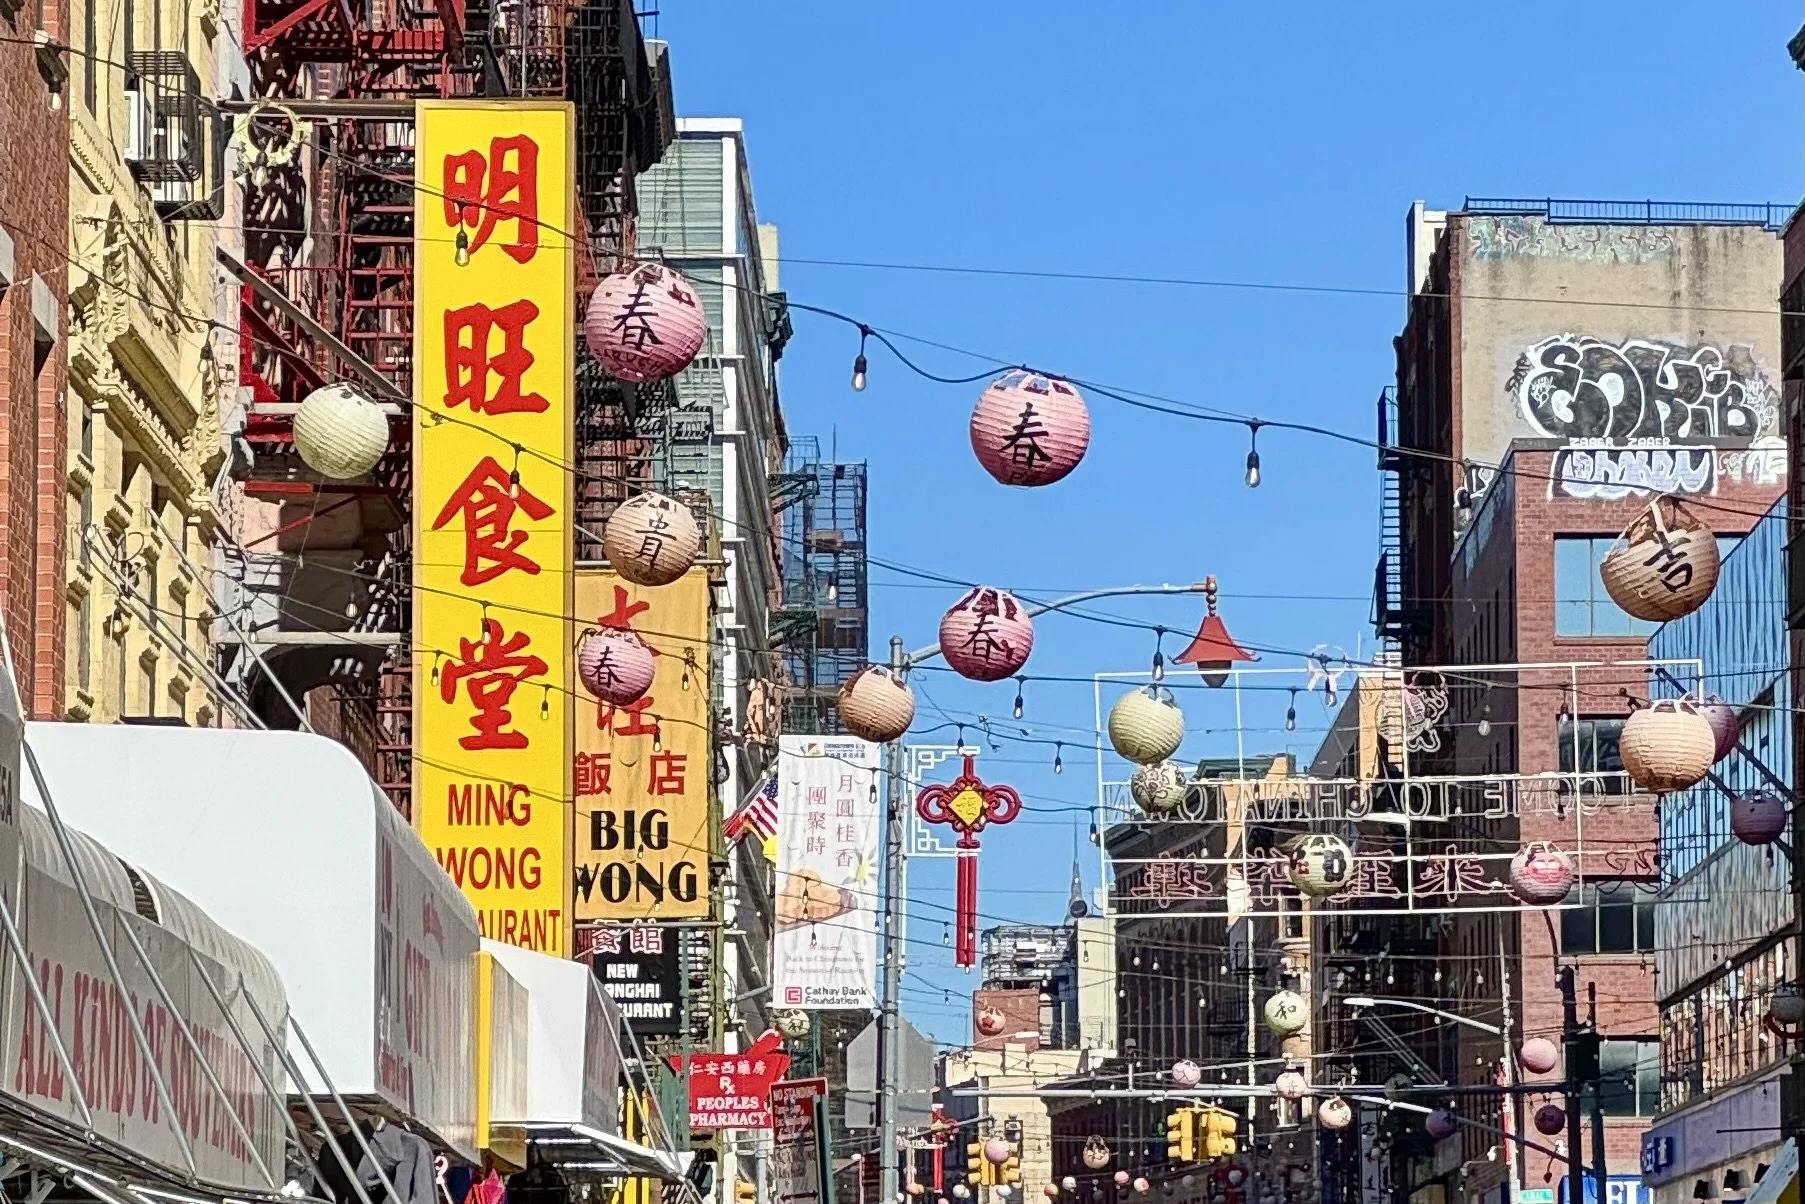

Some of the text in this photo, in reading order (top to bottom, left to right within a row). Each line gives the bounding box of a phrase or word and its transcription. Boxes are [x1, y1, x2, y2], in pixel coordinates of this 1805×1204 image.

[611, 282, 664, 351] 春
[431, 134, 555, 750] 明旺食堂
[998, 402, 1053, 469] 春
[959, 612, 1005, 663] 春
[588, 646, 624, 688] 春
[447, 784, 531, 827] MING
[590, 808, 669, 852] BIG
[436, 847, 541, 890] WONG
[575, 861, 697, 904] WONG
[603, 982, 661, 998] ANGHAI
[606, 963, 639, 979] NEW
[805, 986, 867, 997] Cathay Bank
[618, 1002, 673, 1018] URANT
[805, 996, 860, 1006] Foundation
[16, 952, 63, 1102] ALL
[70, 970, 138, 1118] KINDS
[690, 1112, 767, 1126] PHARMACY
[697, 1097, 759, 1111] PEOPLES
